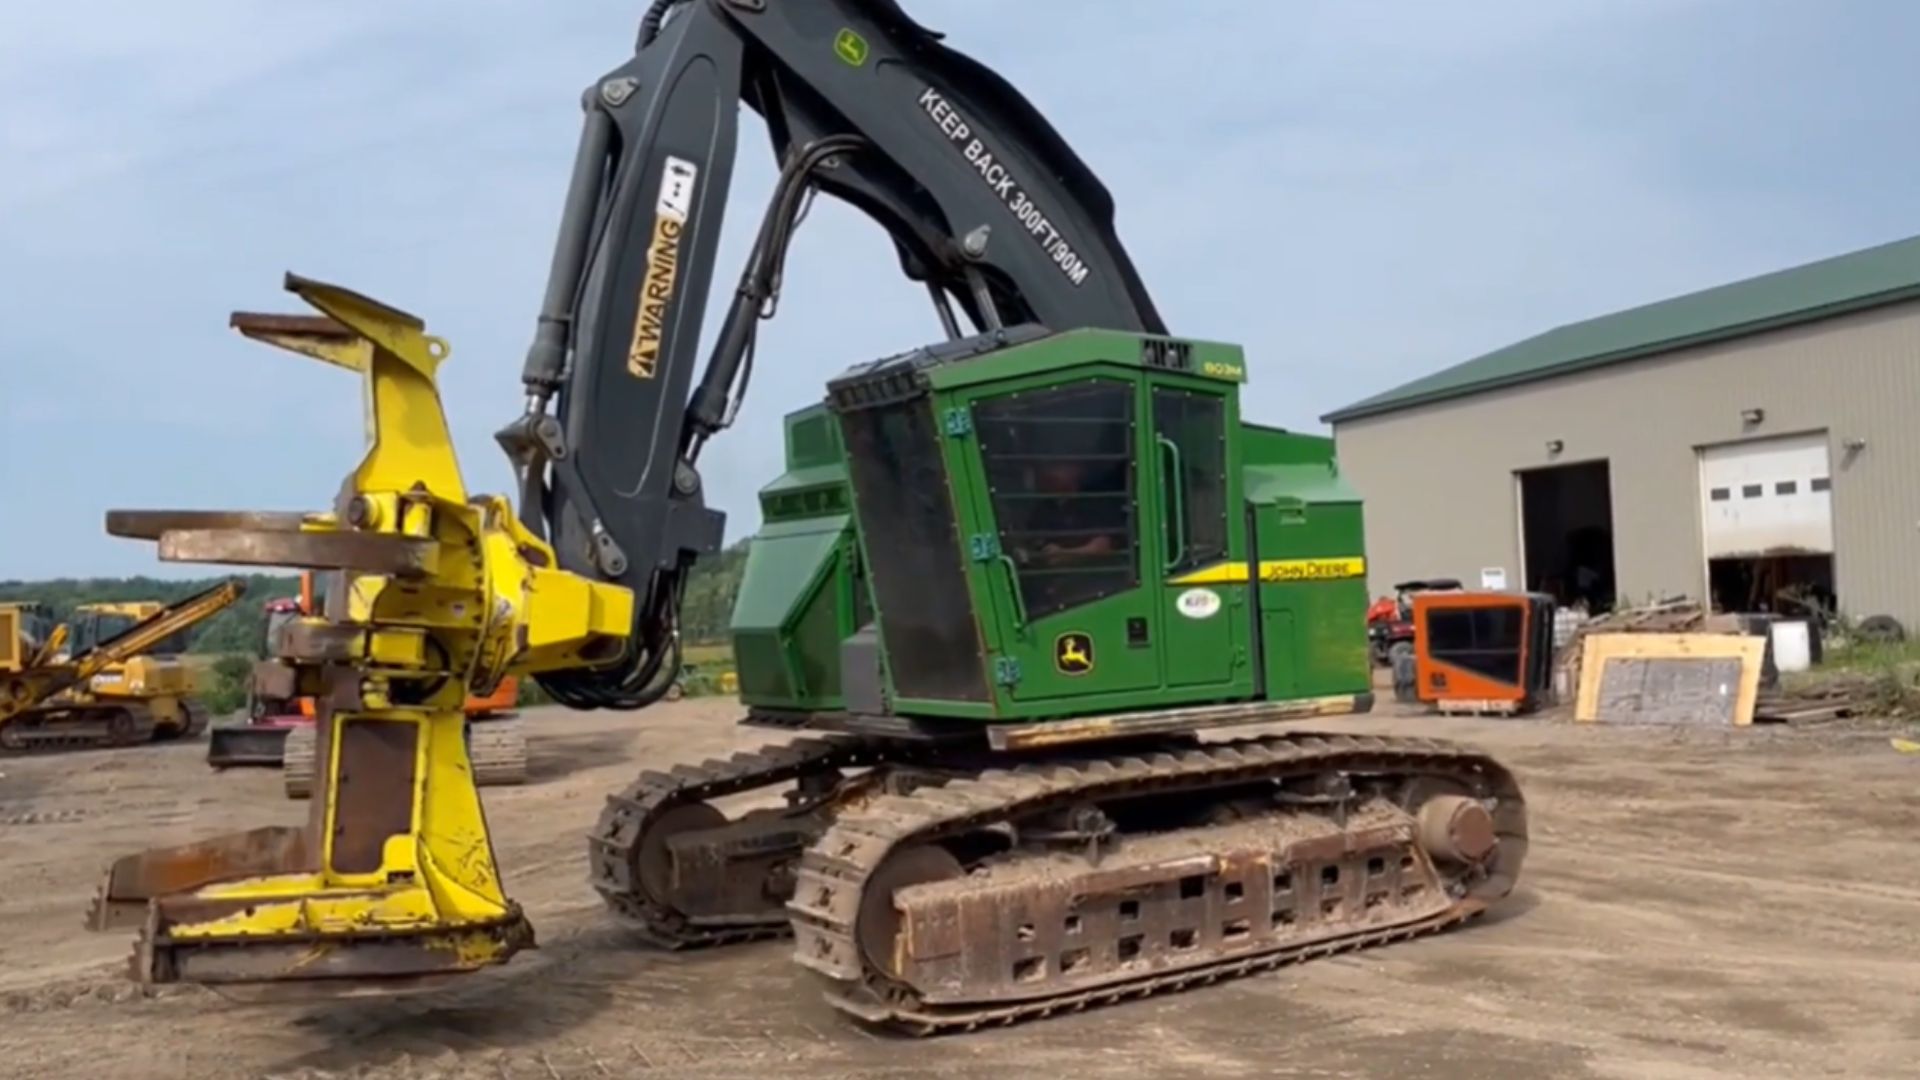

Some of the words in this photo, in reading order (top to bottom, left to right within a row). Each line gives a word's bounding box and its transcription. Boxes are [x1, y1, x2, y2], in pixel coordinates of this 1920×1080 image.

[918, 87, 970, 141] KEEP
[963, 138, 1015, 200] BACK
[1009, 191, 1089, 285] 300FT/90M
[639, 220, 681, 345] WARNING
[1269, 564, 1304, 580] JOHN
[1306, 561, 1350, 577] DEERE
